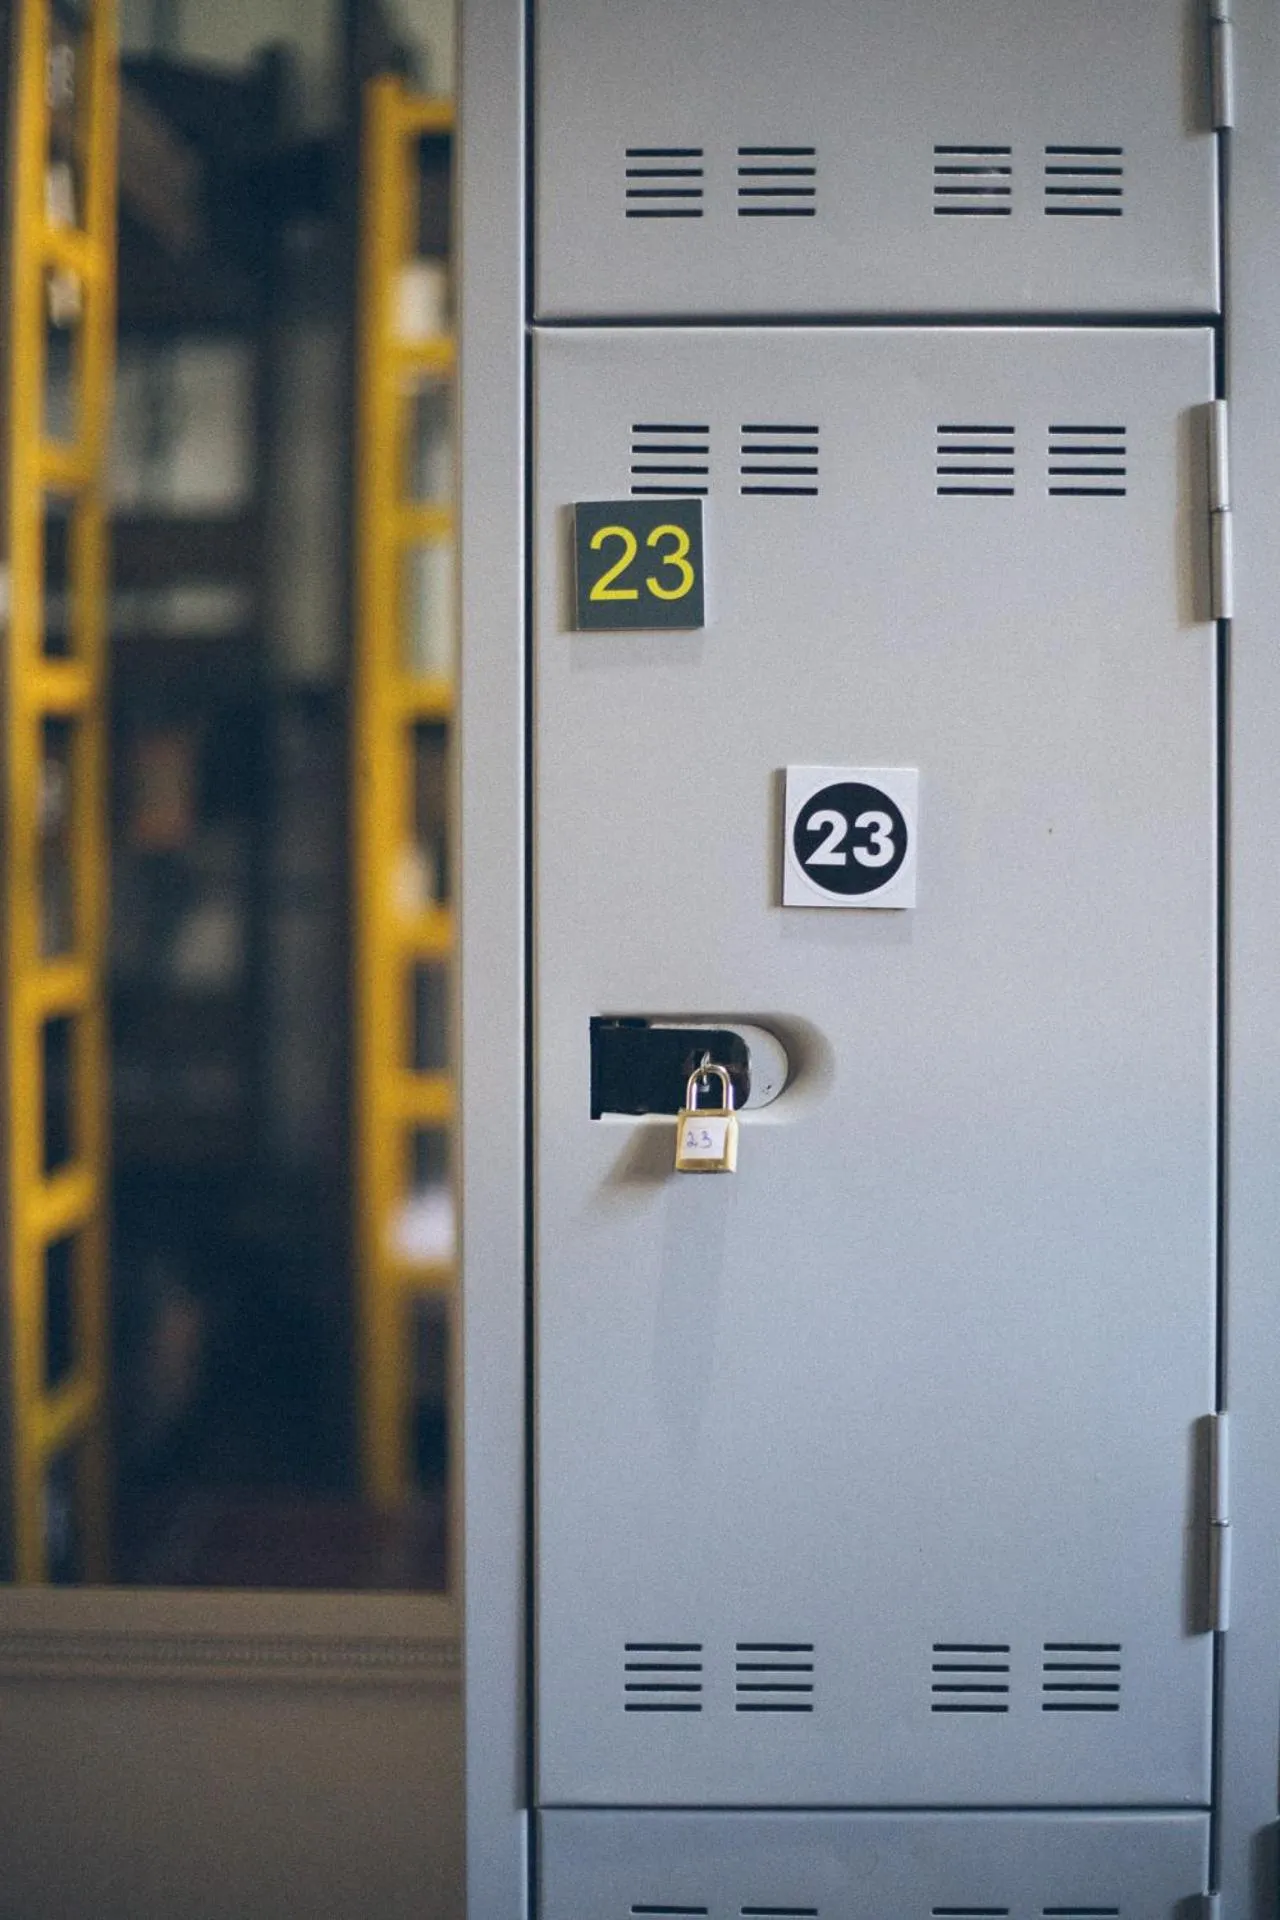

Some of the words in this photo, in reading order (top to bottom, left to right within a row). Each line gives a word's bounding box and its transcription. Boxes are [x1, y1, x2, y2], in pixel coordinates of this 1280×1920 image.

[589, 524, 696, 602] 23
[805, 810, 895, 867] 23
[686, 1130, 713, 1149] 23
